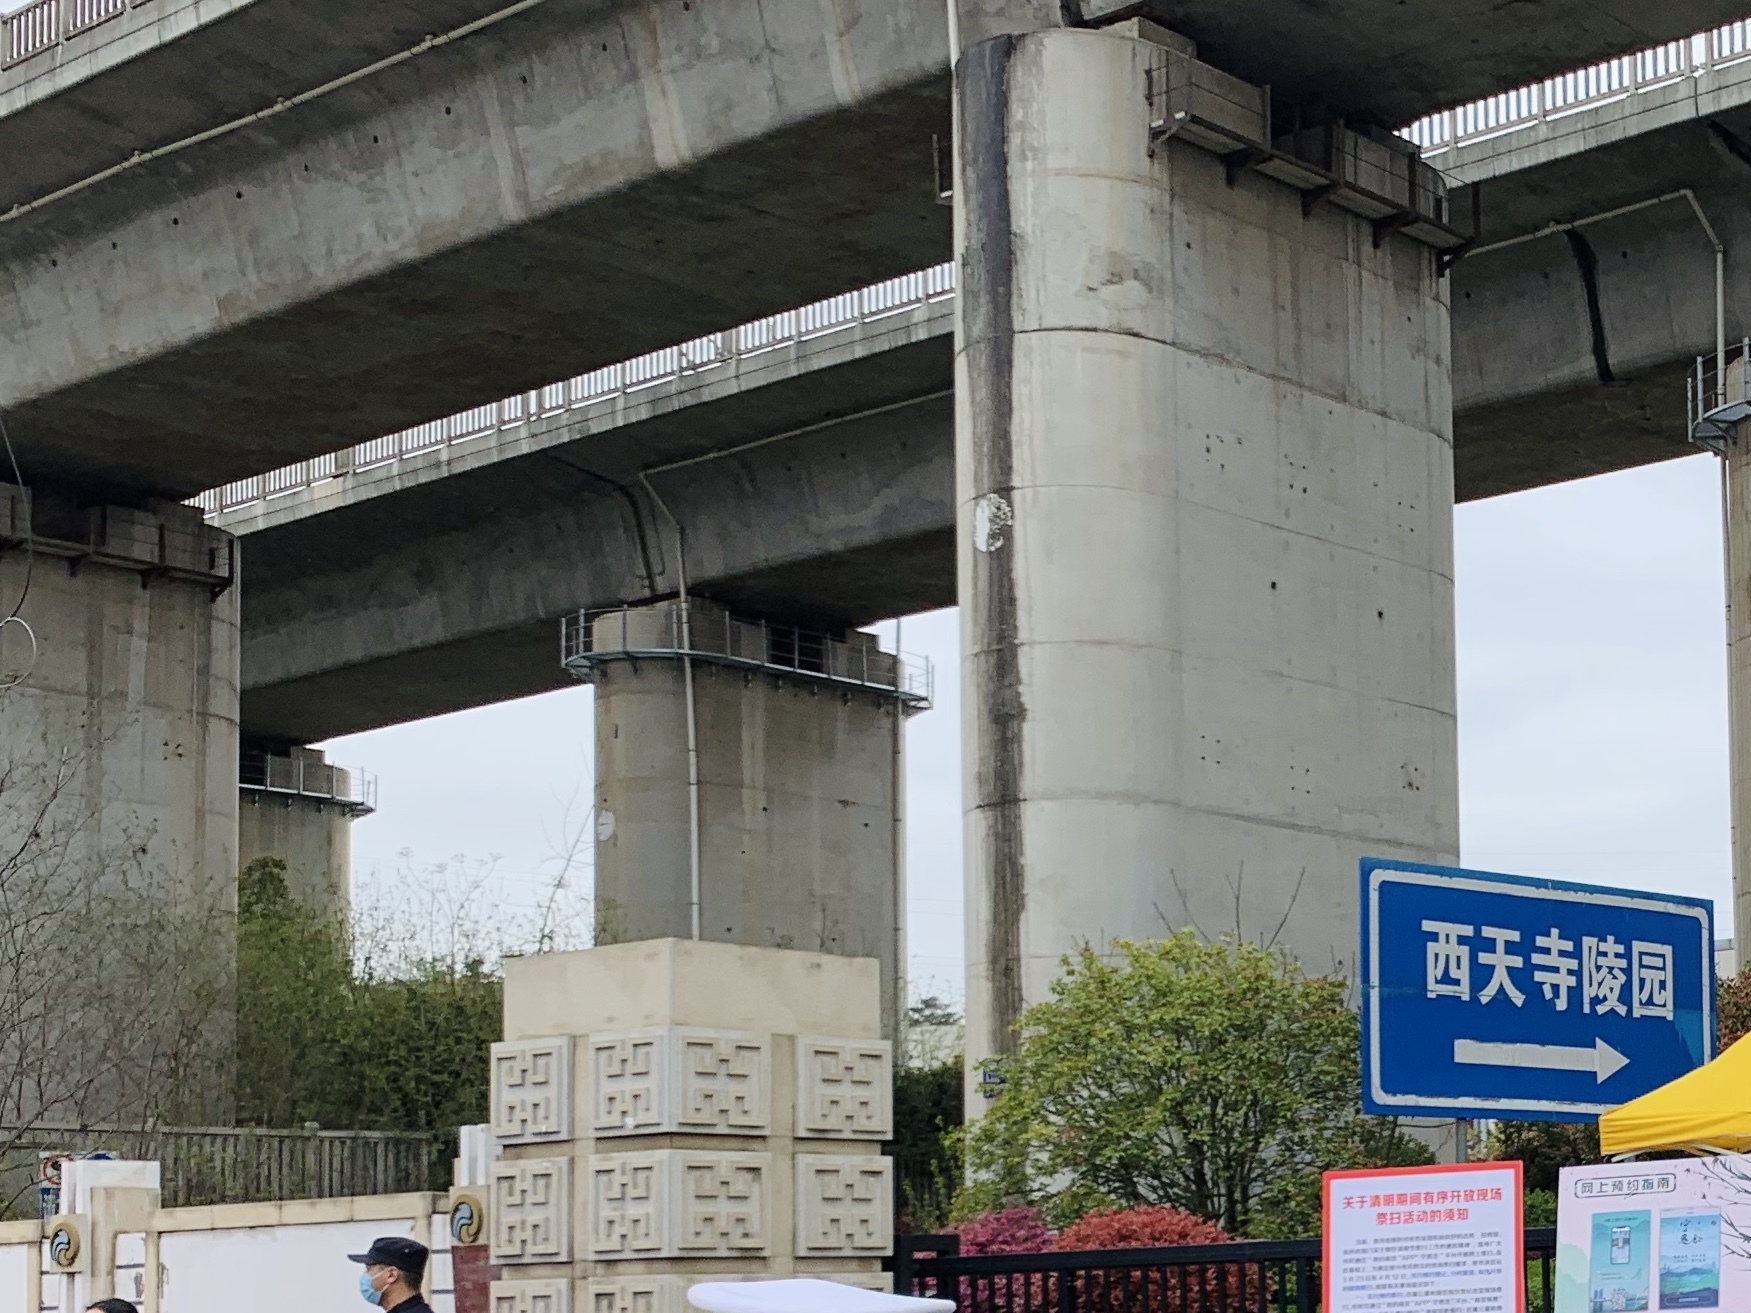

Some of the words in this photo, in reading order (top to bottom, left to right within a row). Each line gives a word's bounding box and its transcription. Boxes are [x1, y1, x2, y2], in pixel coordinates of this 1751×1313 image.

[1421, 919, 1675, 1021] 西天寺陵园
[1581, 1177, 1669, 1194] 网上预约指南
[1342, 1187, 1502, 1209] 关于清明期间有序开放现场
[1375, 1208, 1469, 1226] 祭扫活动的须知
